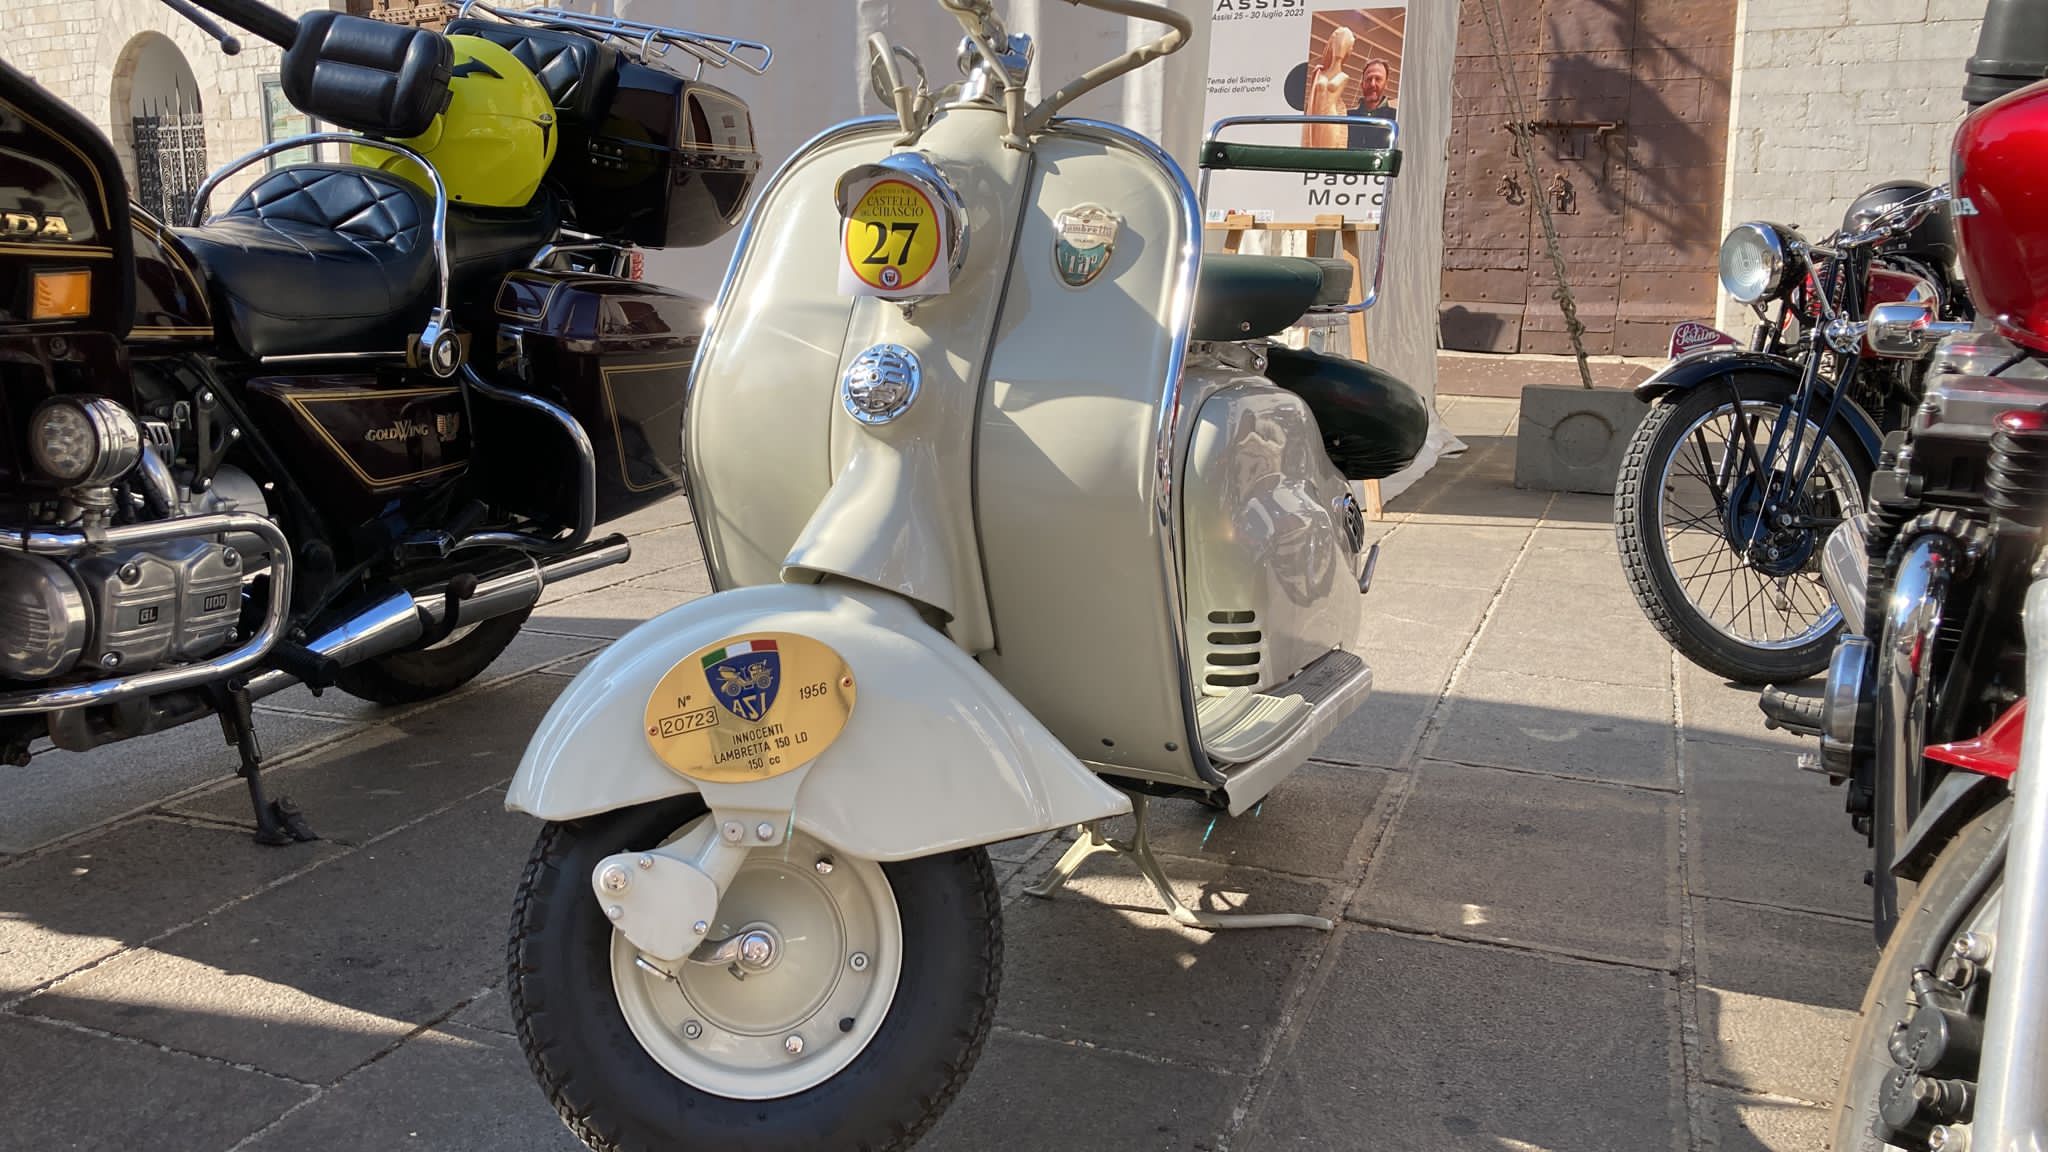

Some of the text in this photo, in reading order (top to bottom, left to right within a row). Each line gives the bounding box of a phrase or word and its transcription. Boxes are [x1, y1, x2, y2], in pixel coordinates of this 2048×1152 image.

[1233, 12, 1243, 20] 25
[1250, 11, 1260, 19] 30
[1261, 10, 1283, 19] luglio
[1284, 8, 1304, 17] 2023
[1239, 76, 1271, 84] Simposio
[872, 207, 924, 217] CHIASCIO
[862, 221, 920, 266] 27
[206, 595, 226, 610] 1100
[140, 609, 157, 623] GL
[800, 682, 828, 700] 1956
[662, 710, 716, 735] 20723
[732, 723, 784, 745] INNOCENTI
[714, 731, 808, 765] LAMBRETTA 150 LD
[748, 756, 781, 771] 150 cc
